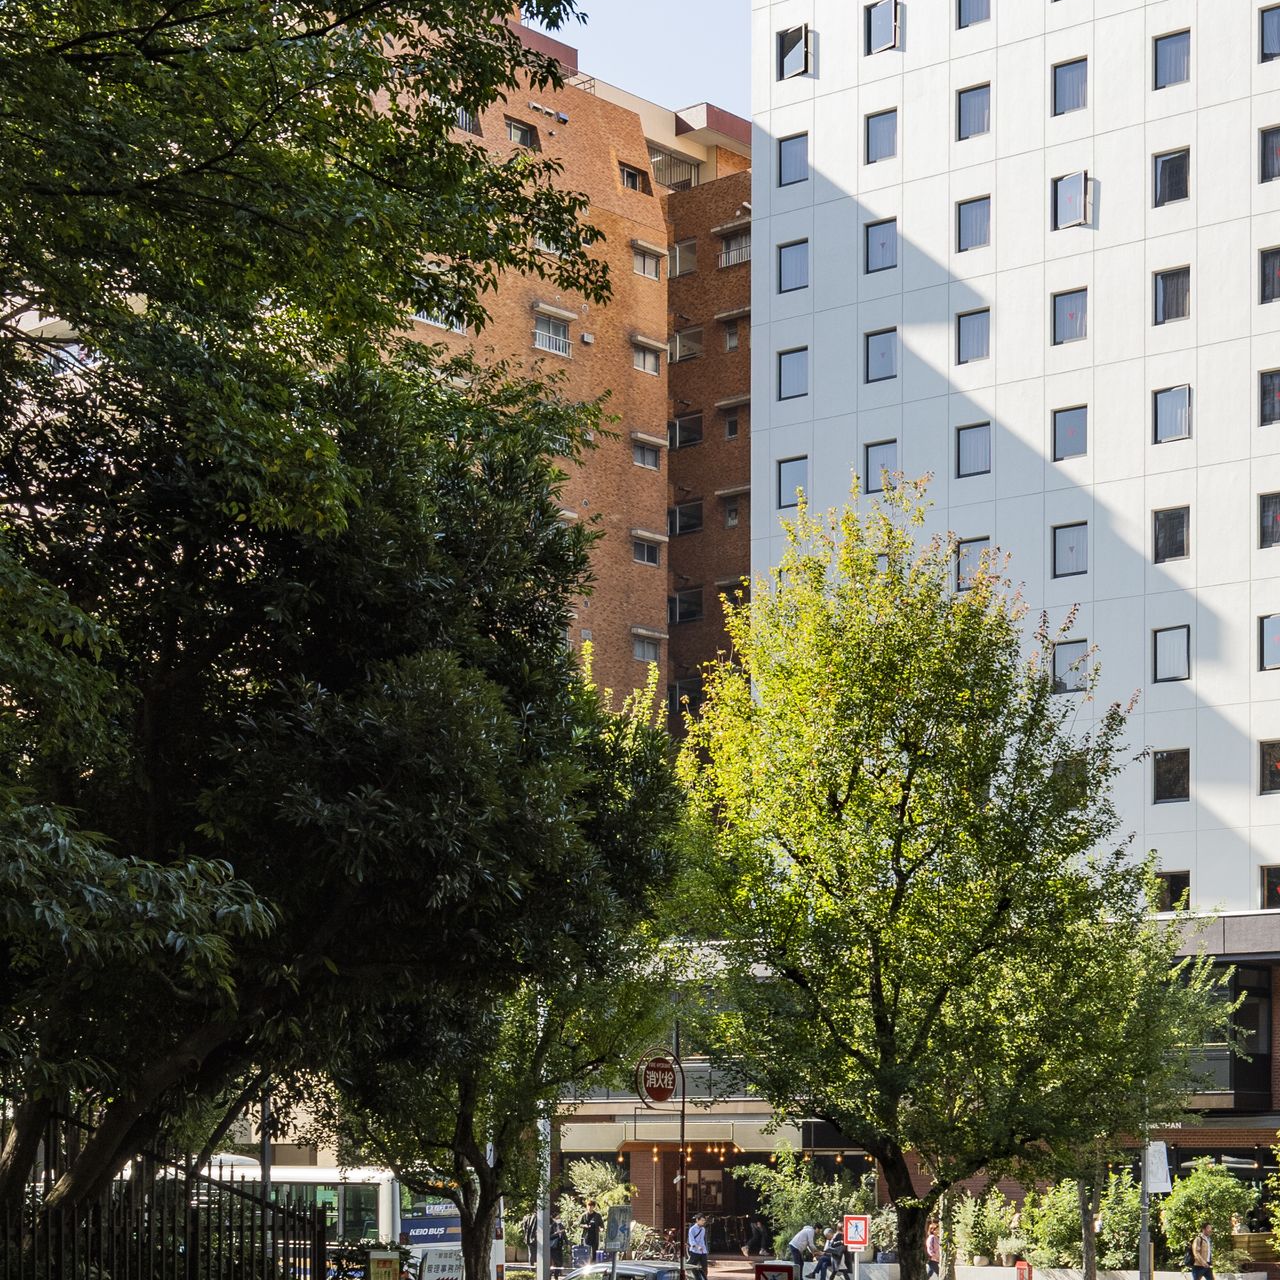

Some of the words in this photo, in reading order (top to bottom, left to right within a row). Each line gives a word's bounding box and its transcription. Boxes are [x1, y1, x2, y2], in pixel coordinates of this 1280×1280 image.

[646, 1070, 674, 1089] 消火栓
[409, 1228, 428, 1236] KEIO
[428, 1227, 445, 1235] BUS
